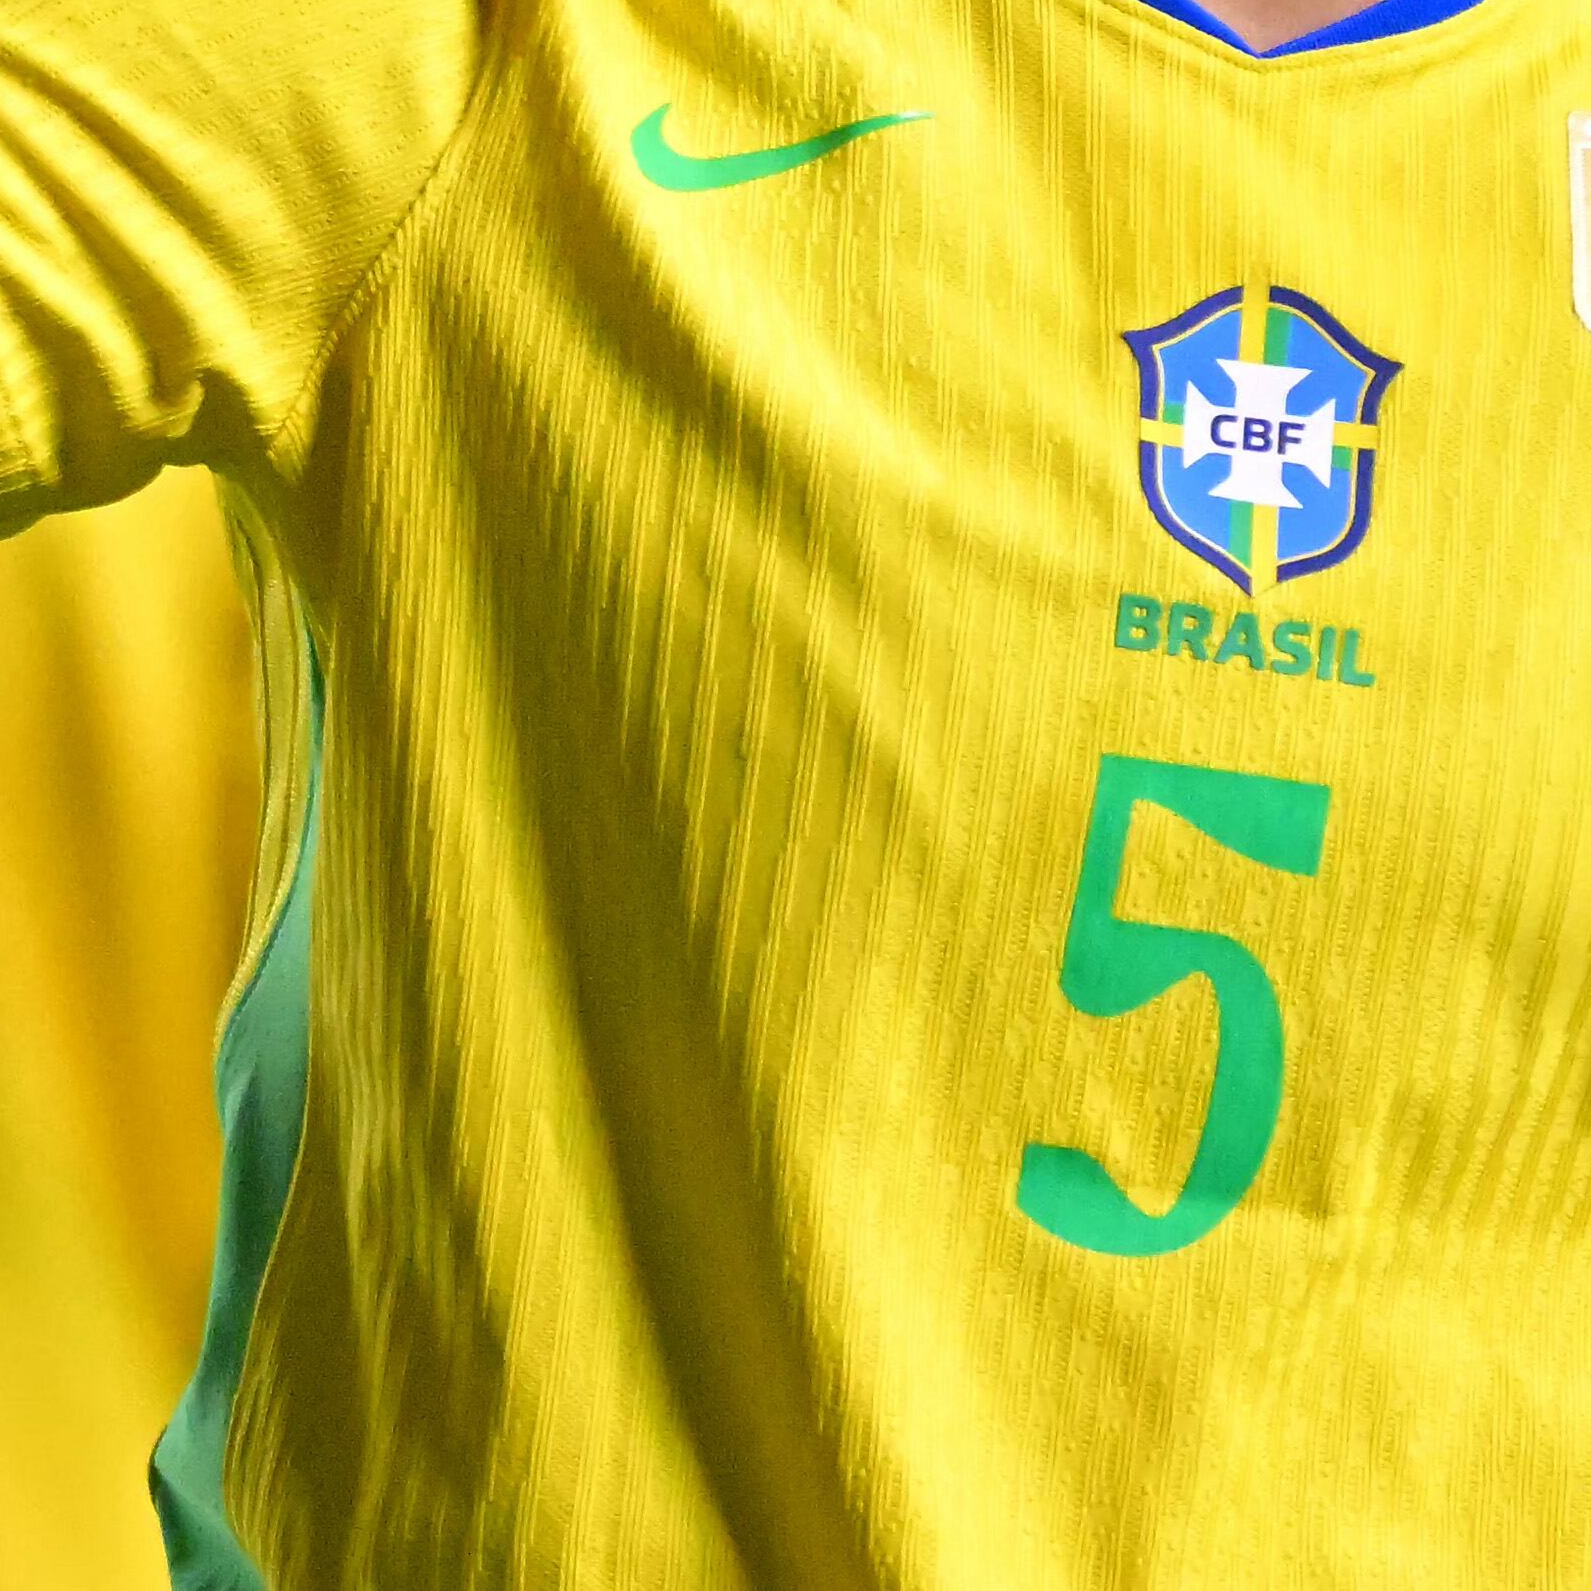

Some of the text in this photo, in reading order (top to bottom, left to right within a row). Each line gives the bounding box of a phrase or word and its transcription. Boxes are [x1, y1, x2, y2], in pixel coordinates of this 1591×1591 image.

[1210, 413, 1306, 455] CBF
[1114, 592, 1376, 687] BRASIL
[1015, 751, 1332, 1257] 5
